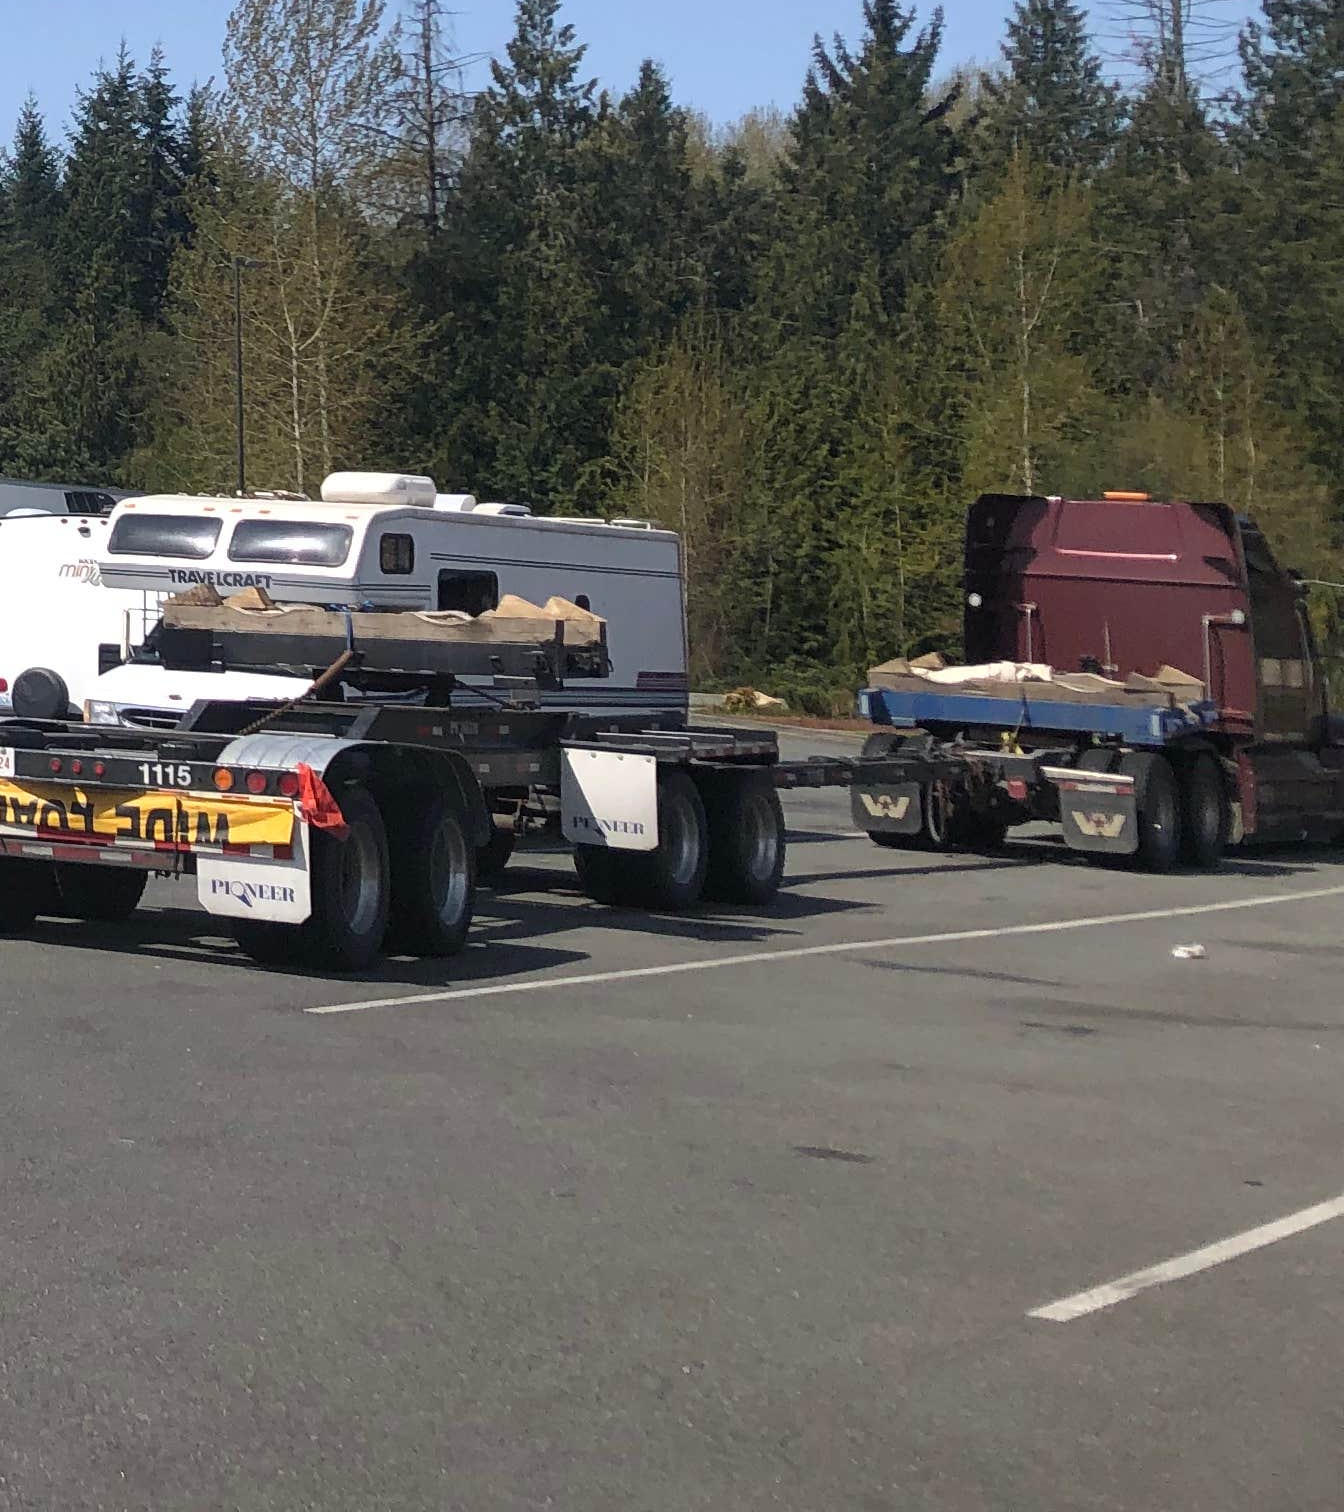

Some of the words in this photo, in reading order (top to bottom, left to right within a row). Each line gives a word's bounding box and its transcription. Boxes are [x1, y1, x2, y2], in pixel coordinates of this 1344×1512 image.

[167, 568, 273, 589] TRAVELCRAFT
[138, 763, 193, 787] 1115
[115, 802, 231, 844] WIDE
[211, 879, 295, 907] PIONEER
